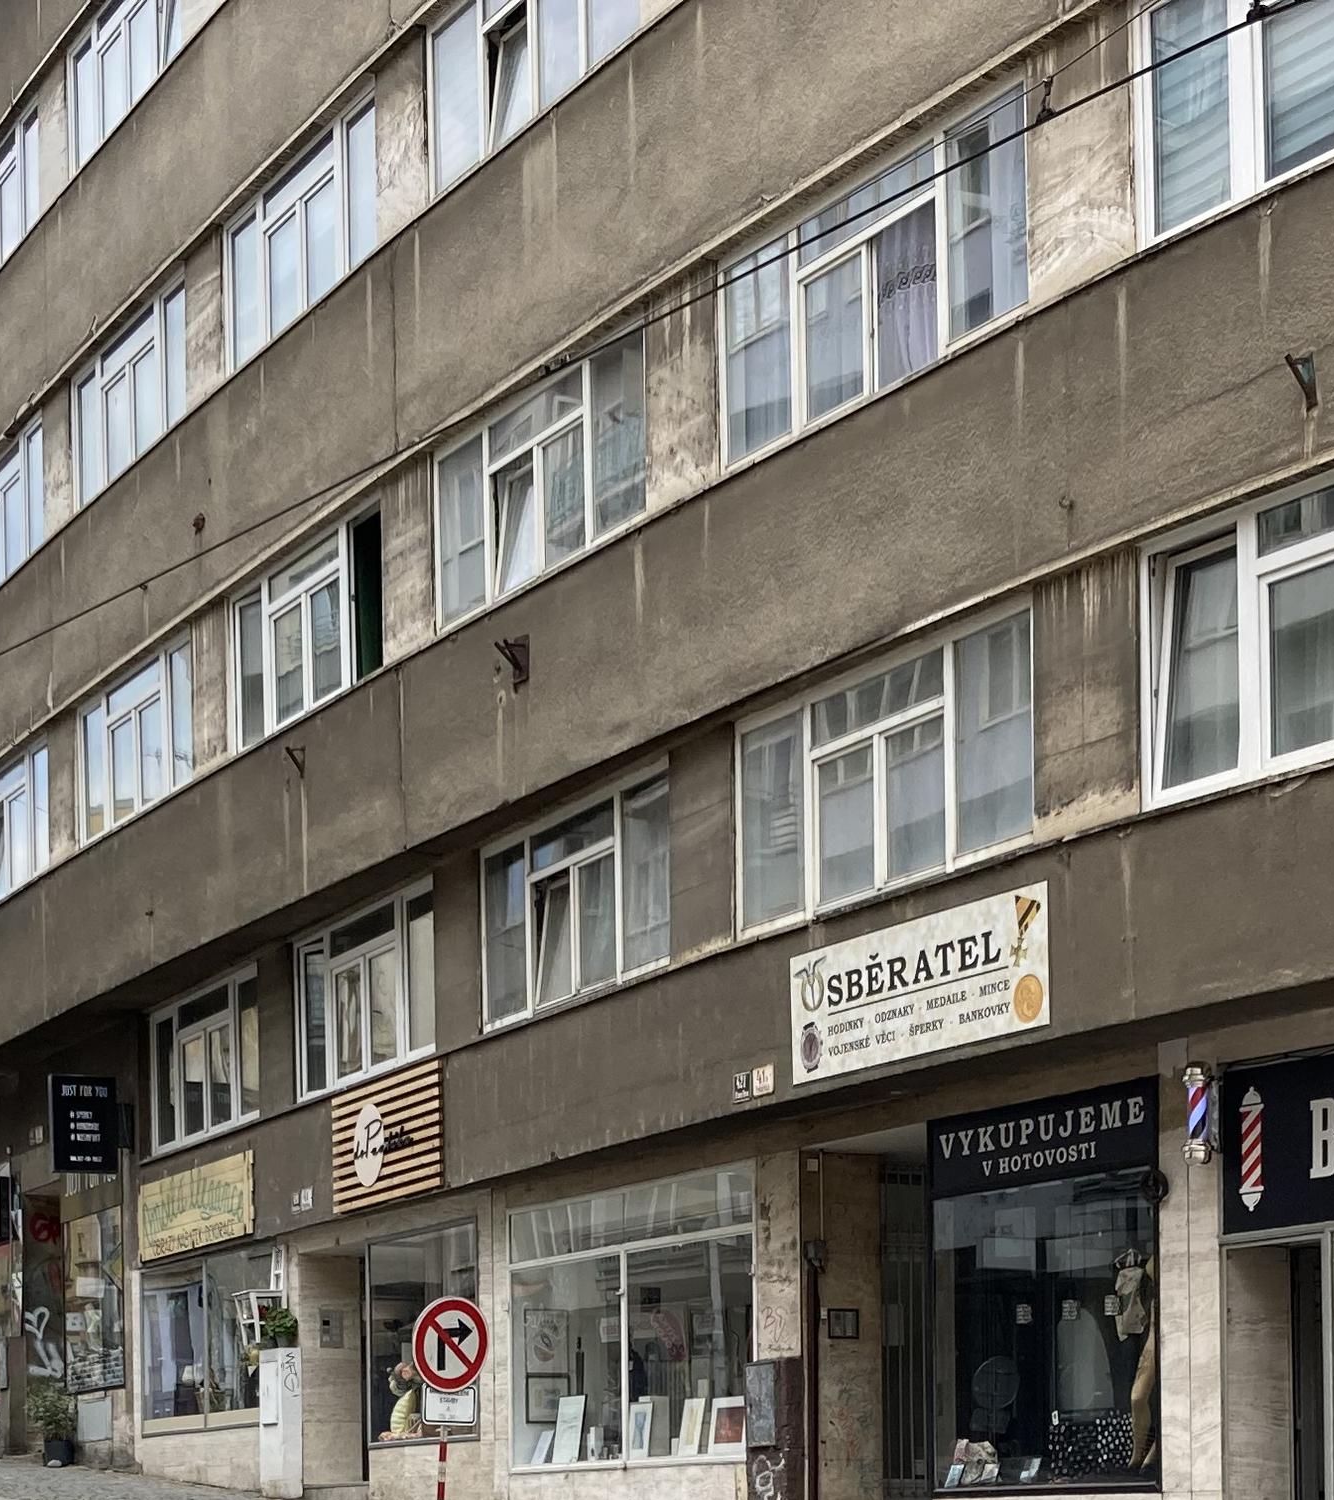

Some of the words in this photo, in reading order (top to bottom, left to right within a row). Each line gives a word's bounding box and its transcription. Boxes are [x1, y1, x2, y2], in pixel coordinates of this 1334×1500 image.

[827, 930, 1001, 1008] SBĚRATEL
[827, 1018, 864, 1037] HODINKY
[874, 1004, 915, 1024] ODZNAKY
[926, 990, 968, 1011] MEDAILE
[979, 979, 1011, 998] MINCE
[828, 1035, 871, 1057] VOJENSKÉ
[875, 1030, 896, 1047] VĚCI
[908, 1018, 945, 1037] ŠPERKY
[959, 1002, 1011, 1025] BANKOVKY
[61, 1084, 77, 1097] JUST
[79, 1085, 93, 1097] FOR
[95, 1086, 108, 1098] YOU
[939, 1096, 1145, 1160] VYKUPUJEME
[982, 1159, 993, 1177] V
[998, 1141, 1097, 1175] HOTOVOSTI
